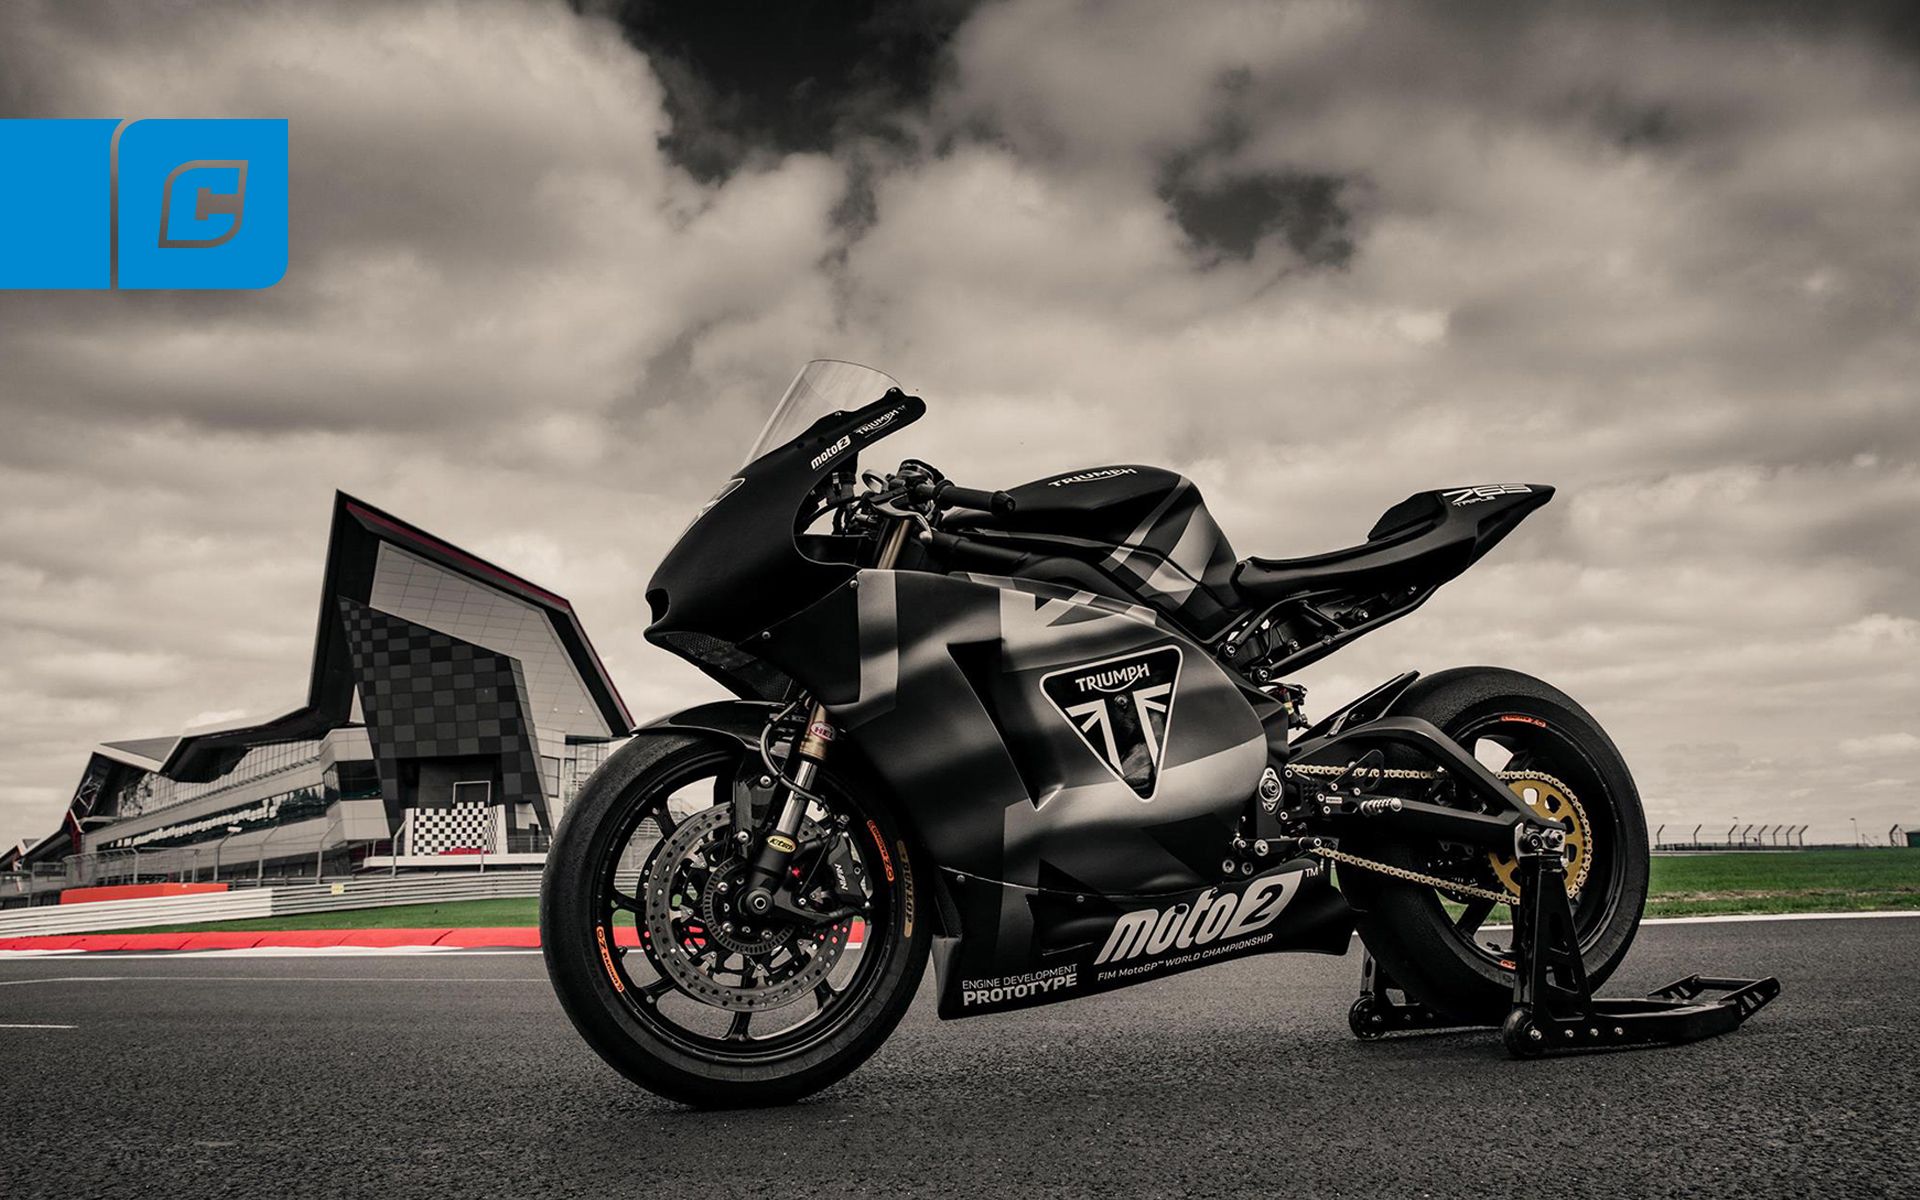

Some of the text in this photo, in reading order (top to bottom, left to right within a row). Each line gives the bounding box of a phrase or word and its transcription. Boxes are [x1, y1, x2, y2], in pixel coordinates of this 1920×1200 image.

[855, 409, 899, 434] TRIUMPH
[1048, 468, 1138, 487] TRIUMPH
[1075, 663, 1150, 692] TRIUMPH
[903, 861, 914, 924] DUNLOP
[1097, 969, 1117, 982] FIM
[1165, 952, 1201, 967] WORLD
[1202, 933, 1274, 959] CHAMPIONSHIP
[962, 963, 1078, 991] ENGINE DEVELOPMENT
[963, 973, 1078, 1006] PROTOTYPE
